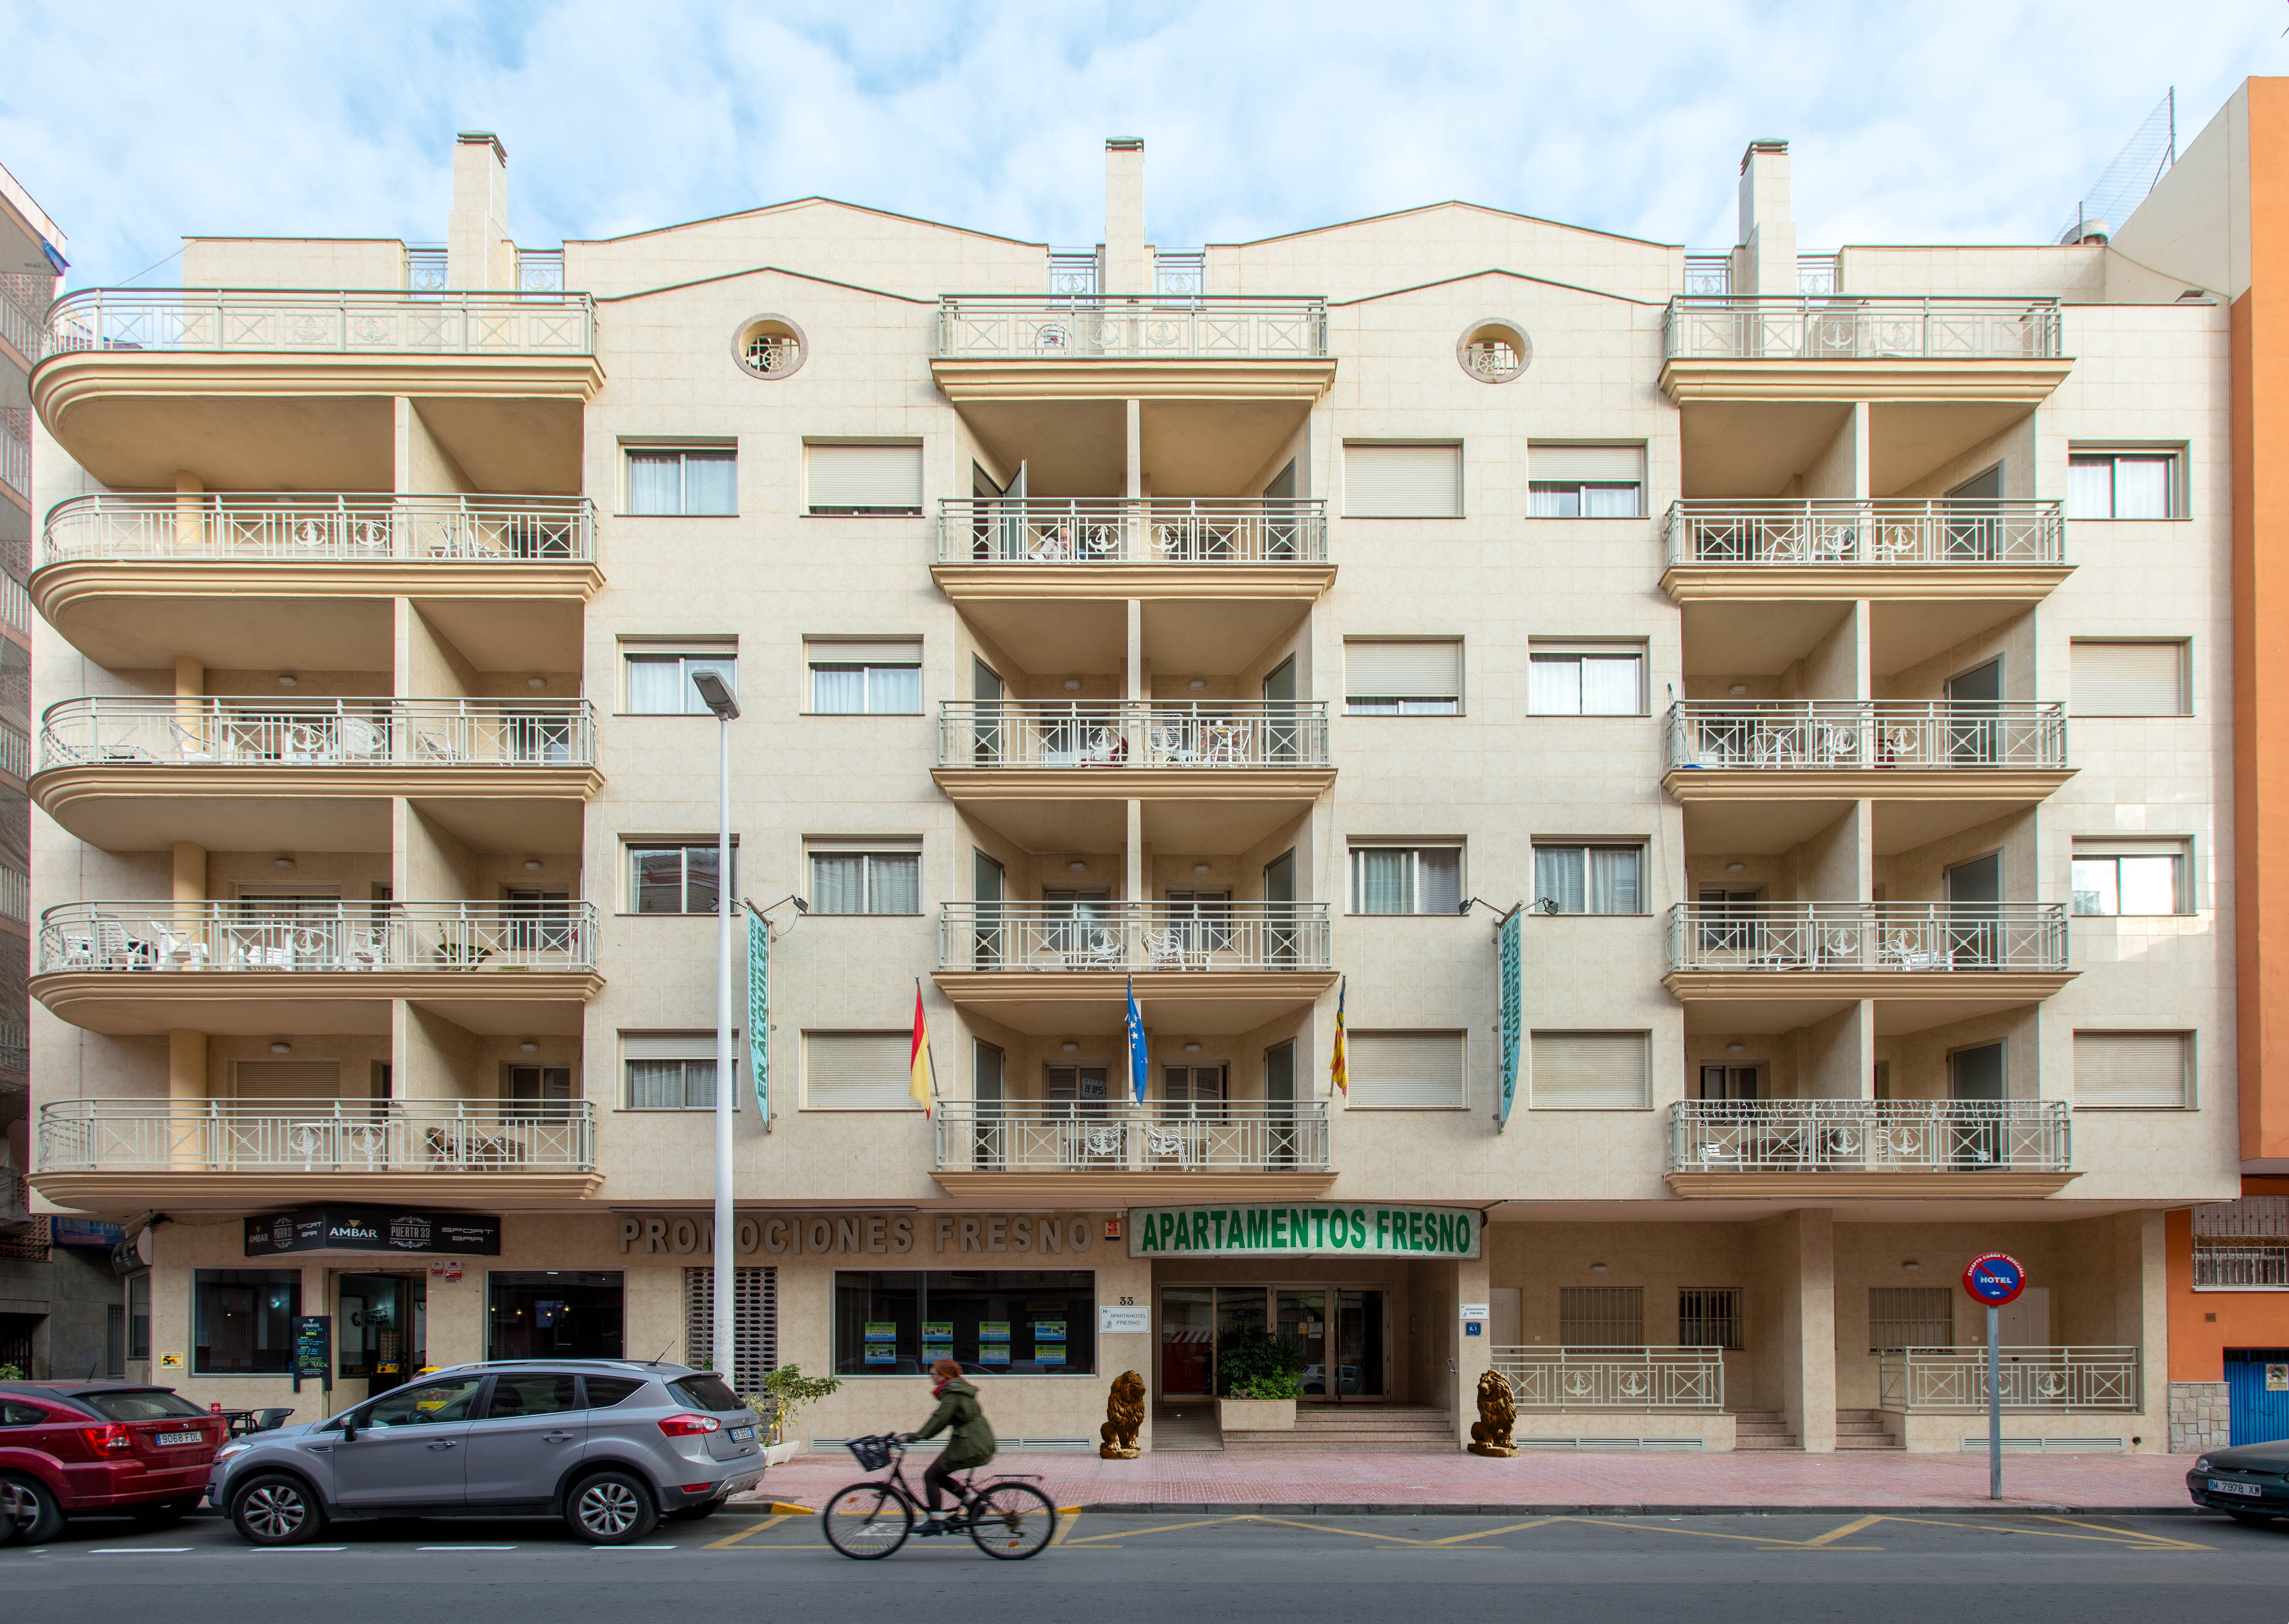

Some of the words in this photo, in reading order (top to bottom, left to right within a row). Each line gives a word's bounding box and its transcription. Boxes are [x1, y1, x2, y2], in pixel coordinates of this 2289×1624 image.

[1511, 917, 1520, 1047] TURISTICOS
[758, 928, 767, 1059] ALQUILER
[1502, 928, 1511, 1099] APARTAMENTOS
[758, 1065, 767, 1101] EN
[249, 1233, 269, 1243] AMBAR
[329, 1227, 379, 1238] AMBAR
[391, 1226, 418, 1238] PUERTA
[420, 1228, 430, 1238] 33
[936, 1217, 1092, 1254] FRESNO
[1142, 1208, 1366, 1252] APARTAMENTOS
[1376, 1211, 1471, 1253] FRESNO
[1967, 1258, 1982, 1276] EXCEPTO
[2006, 1256, 2025, 1277] DESCARGA
[1119, 1297, 1134, 1305] 33
[162, 1434, 184, 1444] 9068
[185, 1433, 200, 1441] FDL
[734, 1430, 740, 1439] EN
[2213, 1481, 2218, 1490] M
[2222, 1482, 2244, 1493] 7978
[2248, 1485, 2260, 1495] XW
